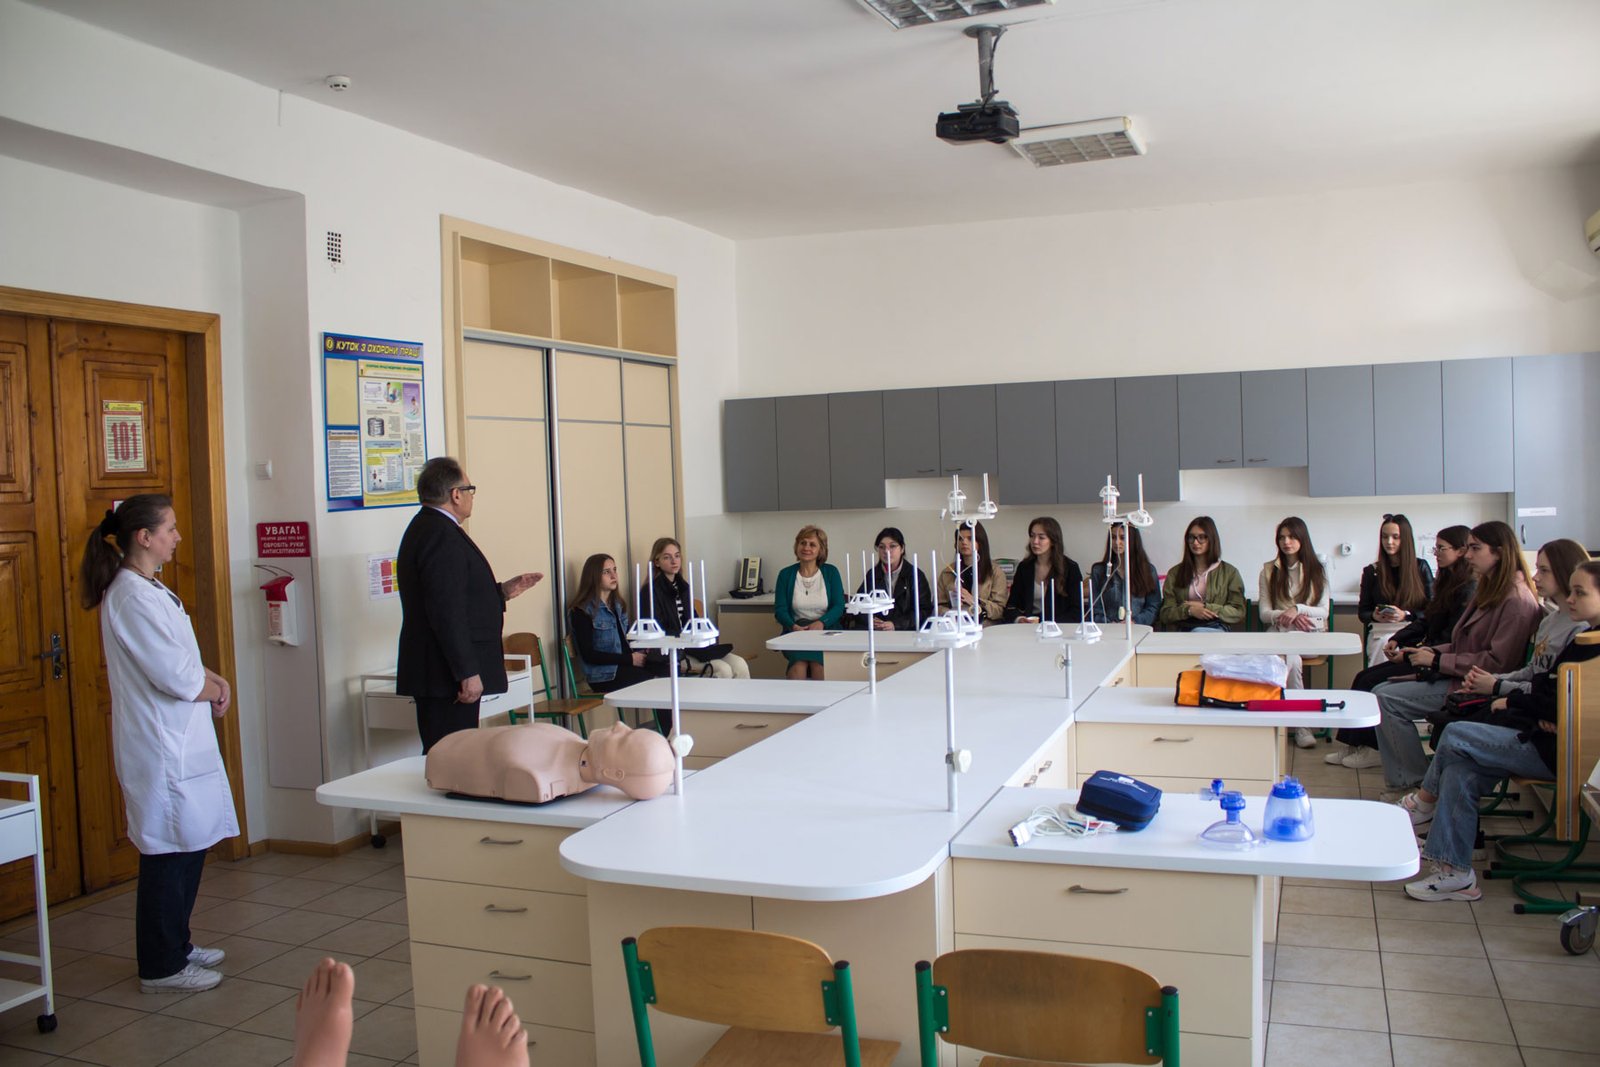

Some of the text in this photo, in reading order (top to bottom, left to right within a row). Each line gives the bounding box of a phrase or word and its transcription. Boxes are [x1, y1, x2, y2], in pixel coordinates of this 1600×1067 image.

[336, 340, 359, 352] КУТОК
[361, 343, 366, 352] З
[367, 344, 398, 355] ОХОРОНИ
[111, 421, 138, 461] 101
[265, 526, 300, 535] УВАГА!
